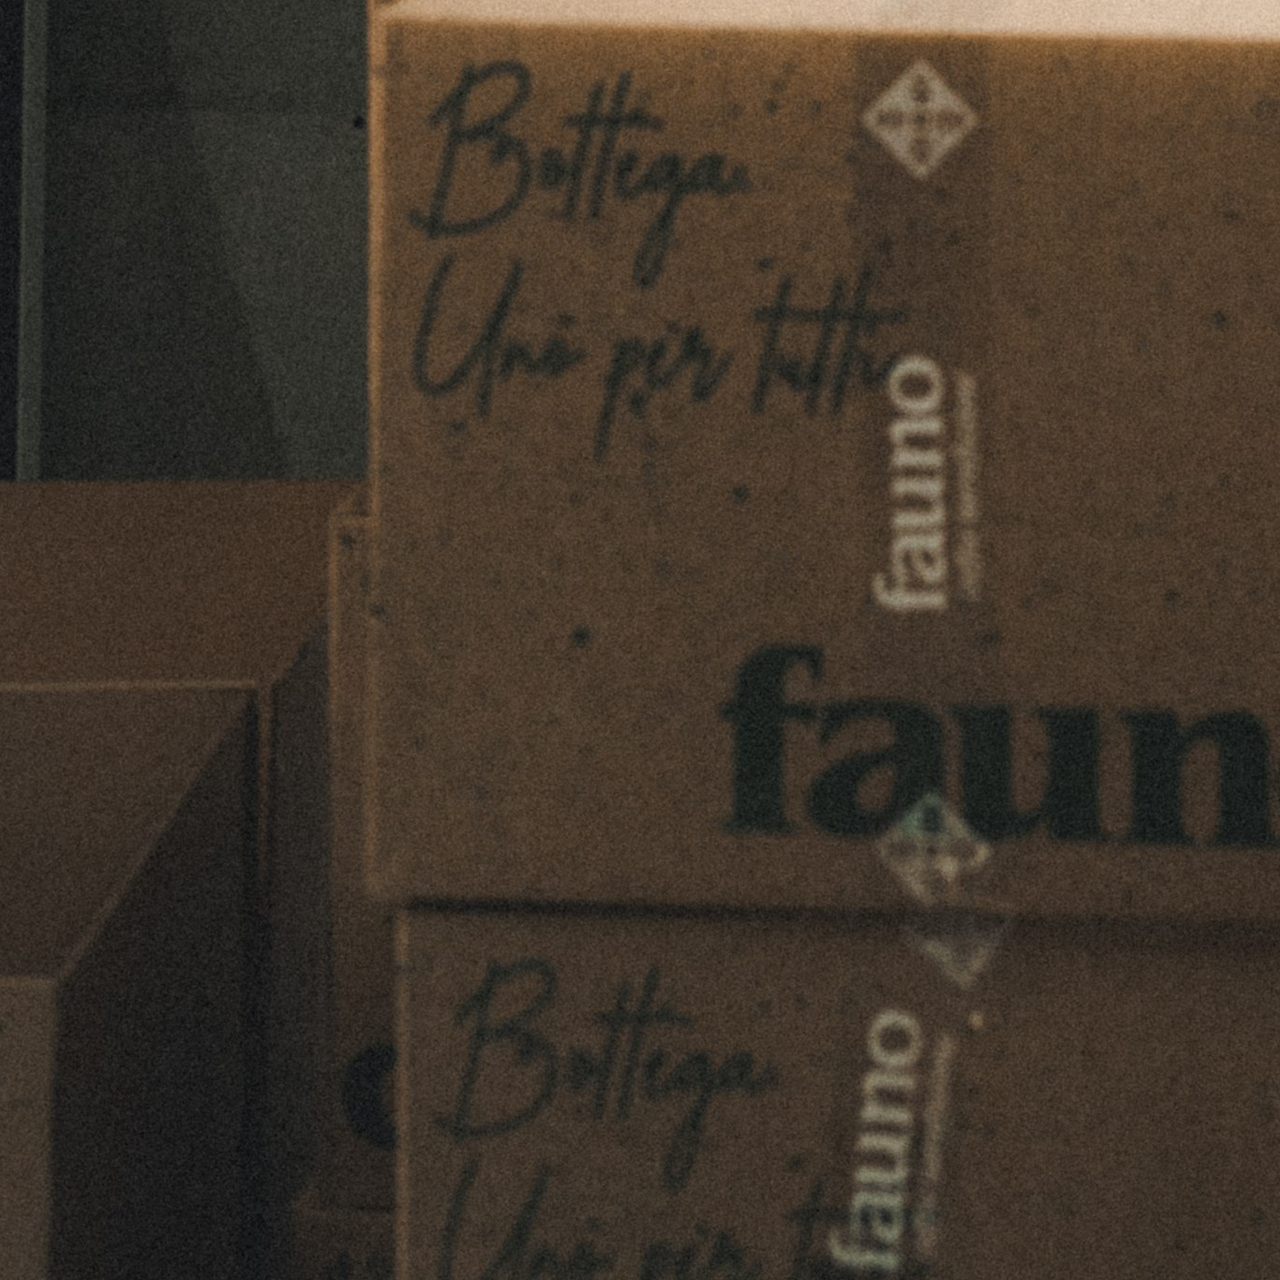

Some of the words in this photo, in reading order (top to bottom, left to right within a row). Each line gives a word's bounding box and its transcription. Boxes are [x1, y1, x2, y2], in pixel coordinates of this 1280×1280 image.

[408, 59, 753, 290] Bottega
[872, 353, 947, 610] fauno
[436, 956, 780, 1191] Bottega
[830, 1009, 925, 1272] fauno
